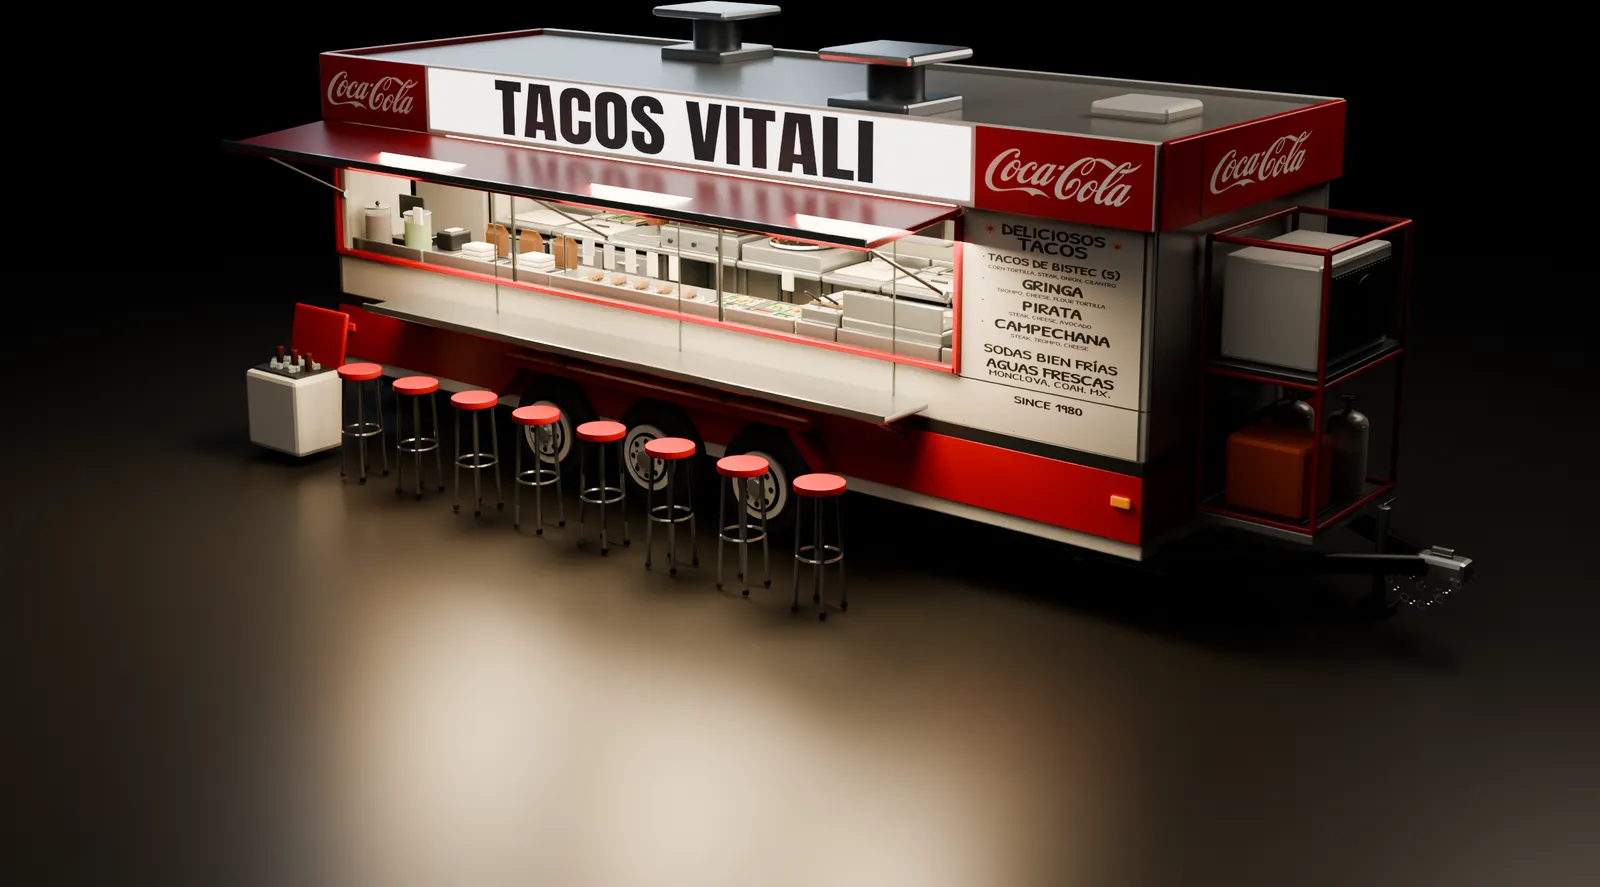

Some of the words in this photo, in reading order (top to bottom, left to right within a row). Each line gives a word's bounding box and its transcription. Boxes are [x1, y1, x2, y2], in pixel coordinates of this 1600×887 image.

[327, 71, 418, 114] Coca-Cola
[495, 79, 664, 154] TACOS
[686, 101, 874, 183] VITALI
[1210, 129, 1313, 195] Coca-Cola
[984, 148, 1142, 208] Coca-Cola
[1002, 223, 1106, 248] DELICIOSOS
[1017, 237, 1088, 260] TACOS
[988, 253, 1030, 267] TACOS
[1032, 260, 1048, 270] DE
[1052, 262, 1097, 277] BISTEC
[1022, 279, 1084, 299] GRINGA
[1085, 279, 1117, 288] CILANTRO
[1022, 301, 1083, 320] PIRATA
[1053, 296, 1074, 305] FLOUR
[1076, 300, 1106, 310] TORTILLA
[994, 318, 1111, 348] CAMPECHANA
[1059, 320, 1092, 330] AVOCADO
[984, 343, 1032, 360] SODAS
[1036, 353, 1071, 368] BIEN
[1075, 359, 1118, 376] FRÍAS
[1064, 343, 1089, 352] CHEESE
[986, 358, 1039, 376] AGUAS
[1042, 367, 1115, 391] FRESCAS
[988, 369, 1051, 388] MONCLOVA,
[1054, 381, 1087, 394] COAH.
[1090, 388, 1111, 399] MX.
[1013, 395, 1051, 410] SINCE
[1055, 404, 1083, 417] 1980
